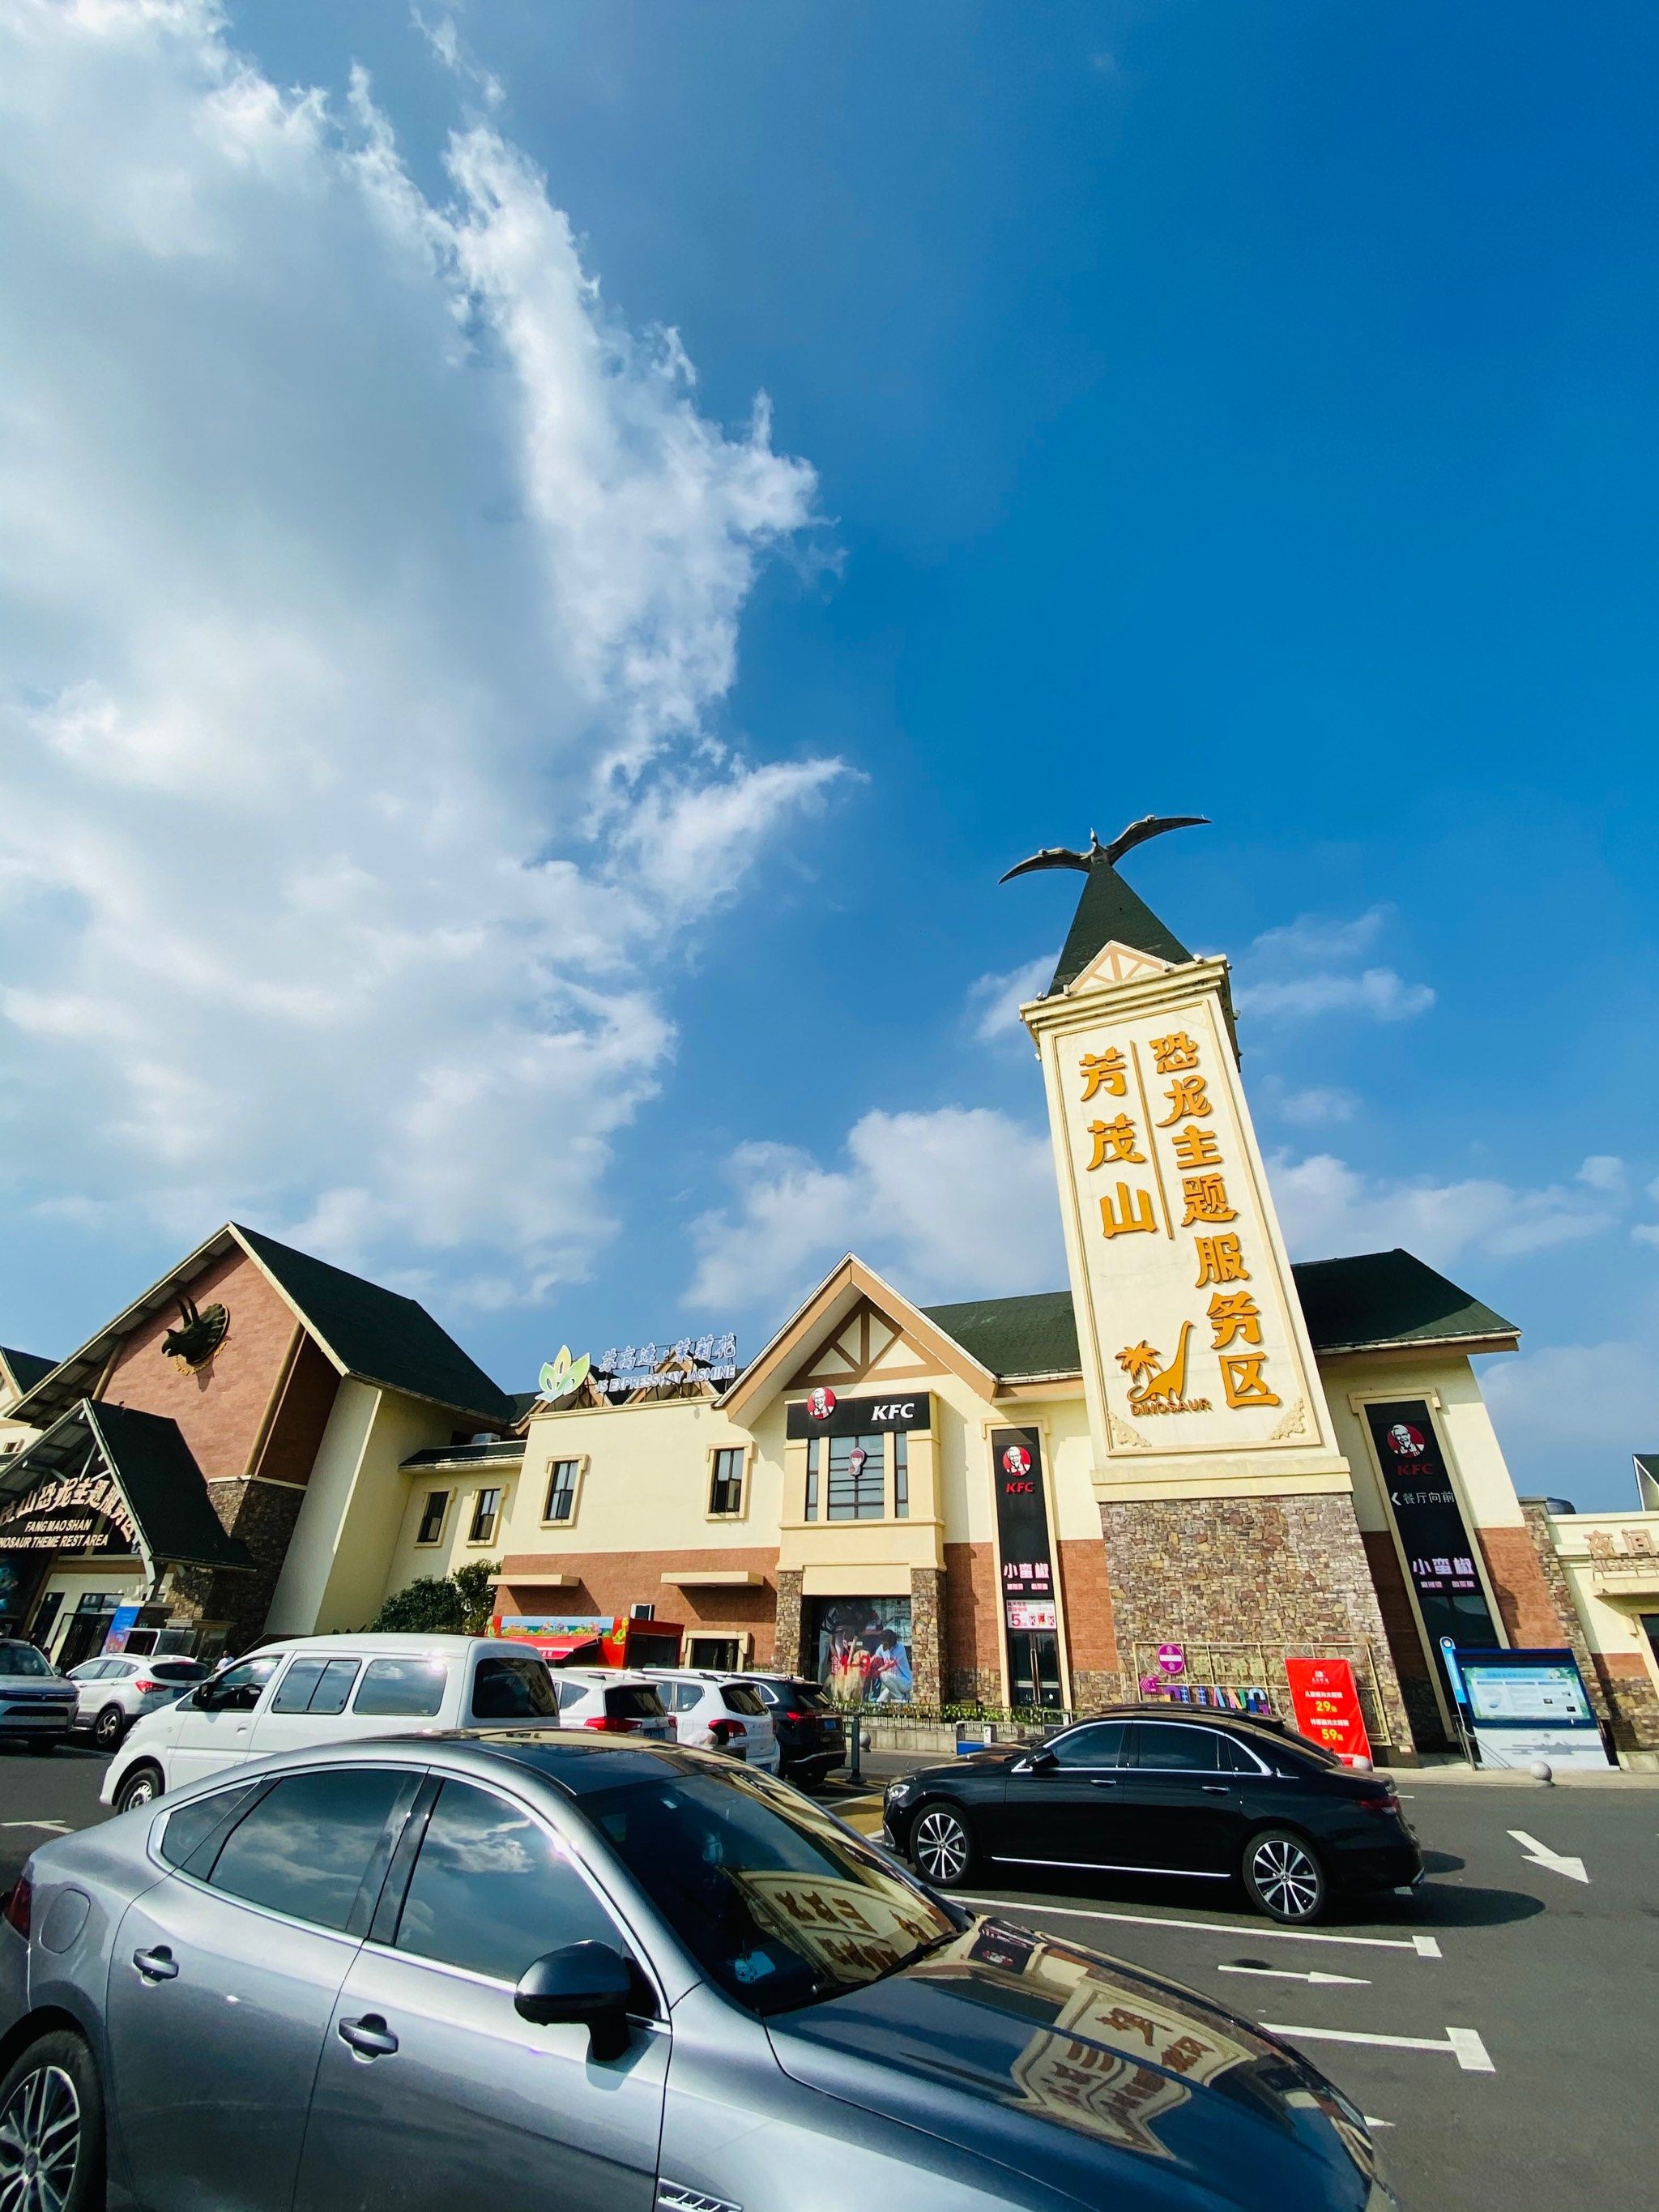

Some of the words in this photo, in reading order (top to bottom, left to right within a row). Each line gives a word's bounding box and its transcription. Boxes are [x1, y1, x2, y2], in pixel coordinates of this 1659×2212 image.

[1079, 1045, 1158, 1240] 芳茂山
[1149, 1031, 1282, 1411] 恐龙主题服务区
[609, 1370, 684, 1391] EXPRESSWAY
[684, 1364, 737, 1384] JASMINE
[871, 1403, 915, 1421] KFC
[1130, 1399, 1211, 1416] DINOSAUR
[1397, 1463, 1433, 1475] KFC
[1005, 1481, 1034, 1493] KFC
[1402, 1491, 1455, 1504] 餐厅向前
[31, 1536, 61, 1548] THEME
[59, 1534, 85, 1547] REST
[82, 1534, 109, 1546] AREA
[1583, 1529, 1657, 1560] 夜间
